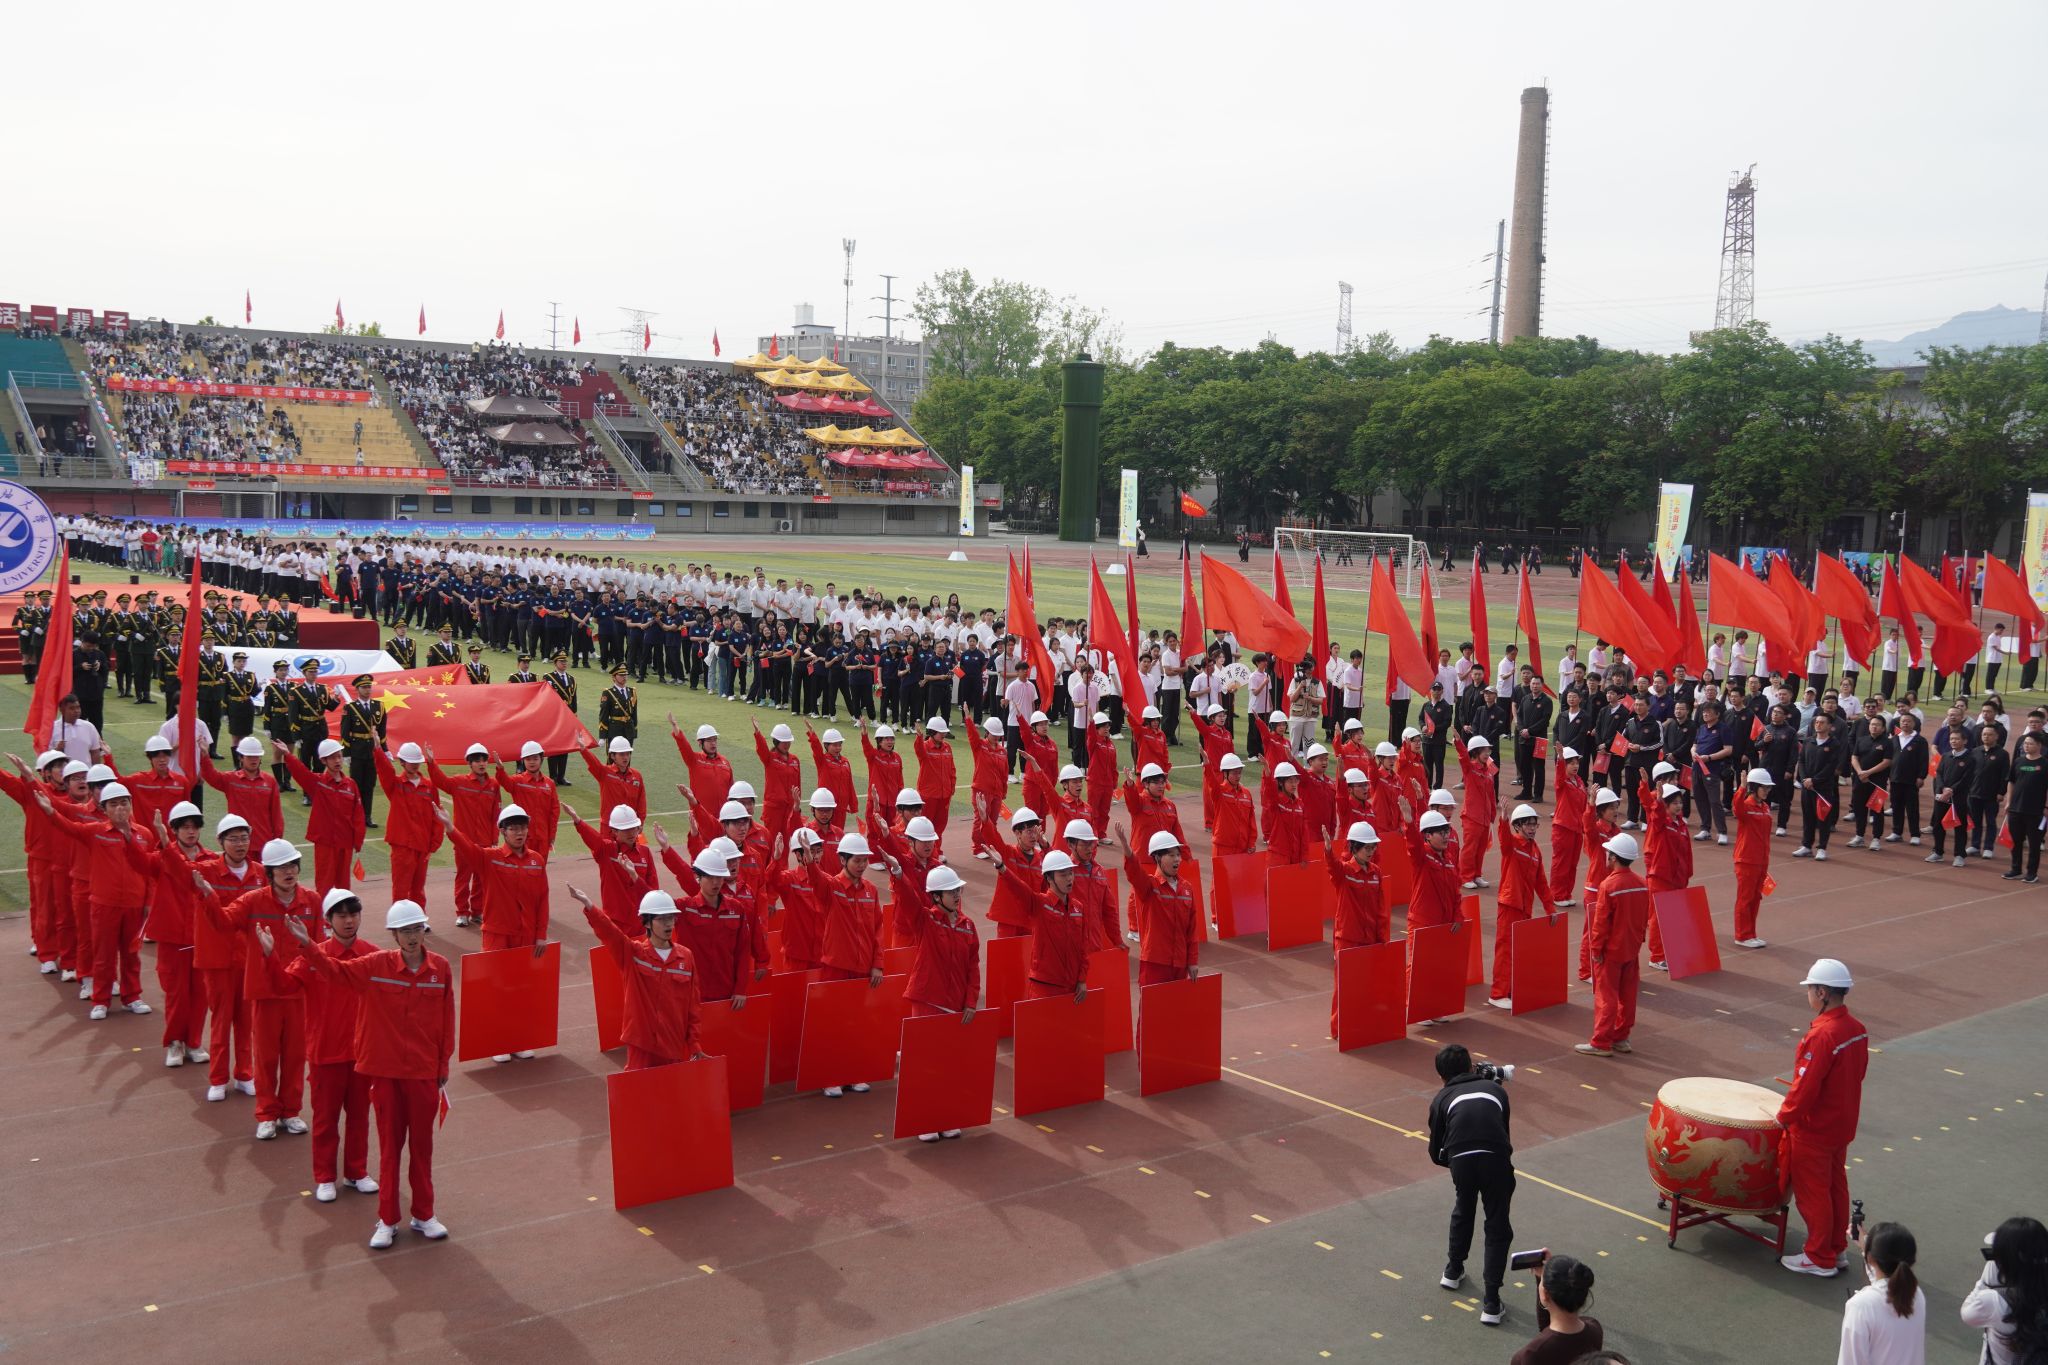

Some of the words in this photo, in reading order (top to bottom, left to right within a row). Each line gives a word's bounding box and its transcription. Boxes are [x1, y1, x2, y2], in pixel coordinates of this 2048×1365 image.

[188, 462, 304, 473] 经管健儿展风采
[320, 465, 429, 477] 赛场拼搏创辉煌
[3, 537, 49, 586] UNIVERSITY
